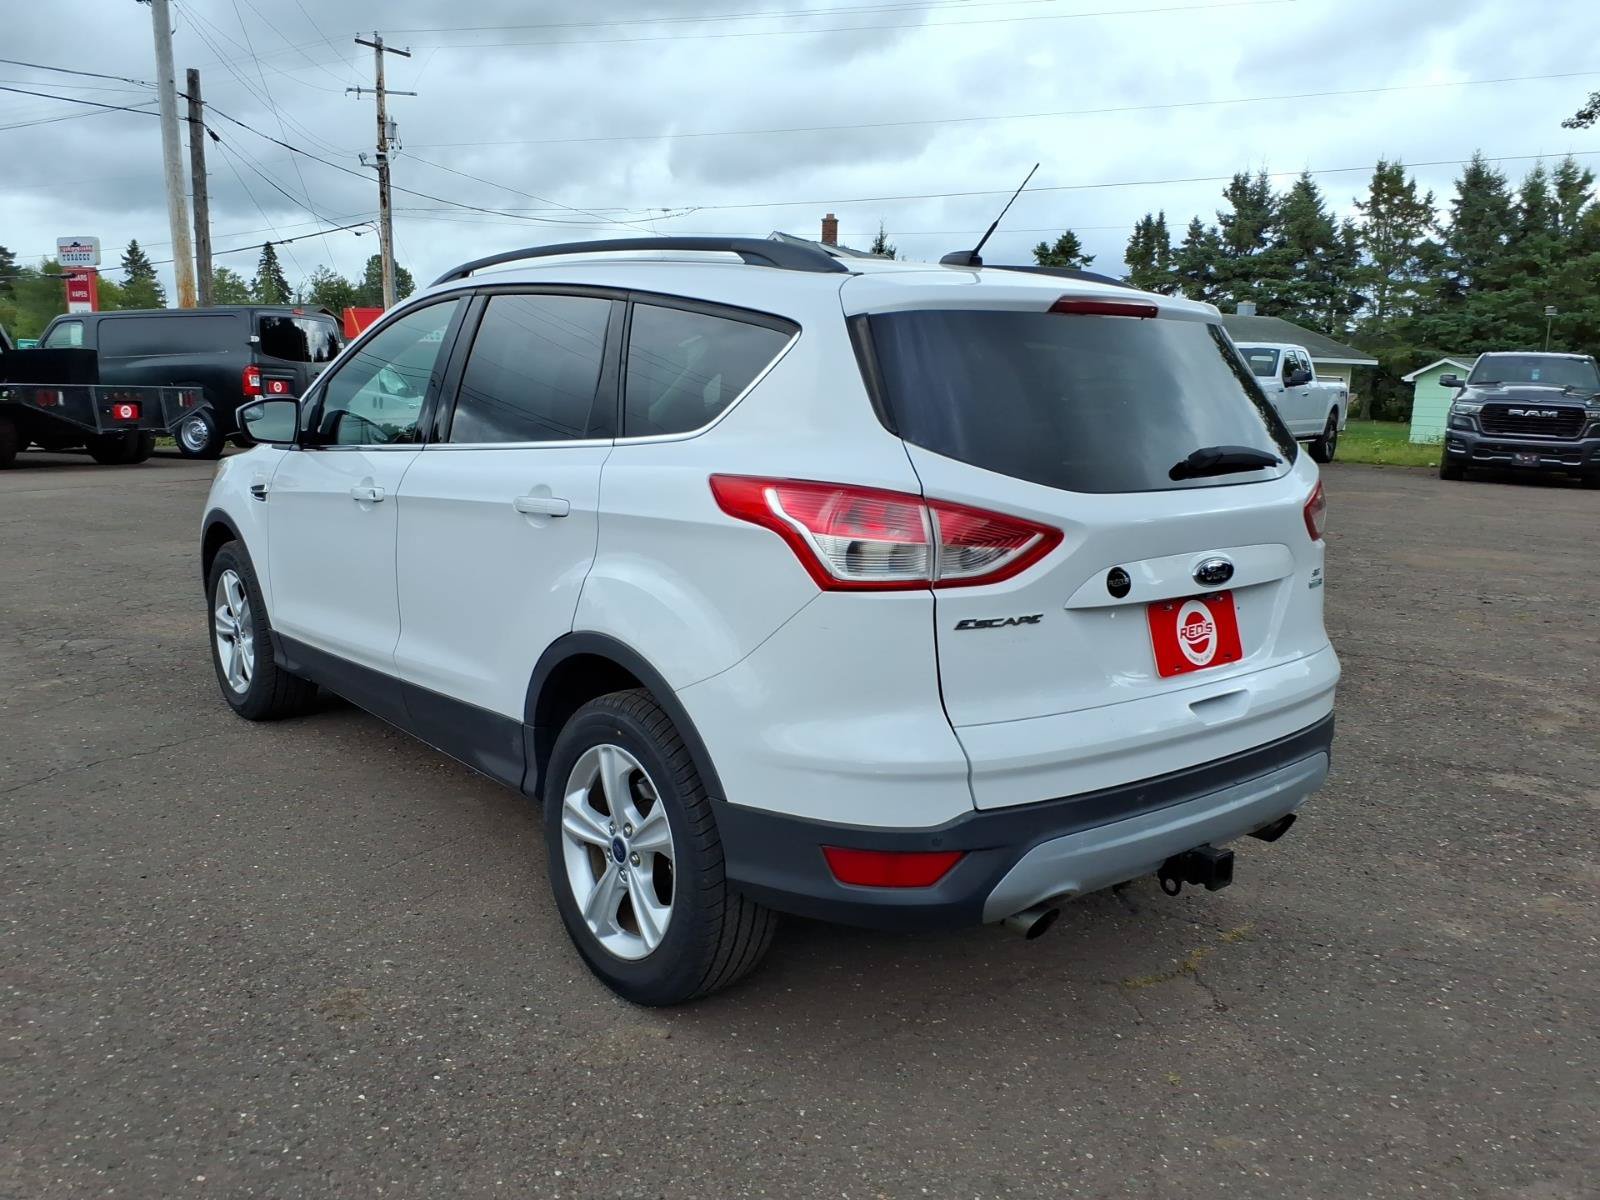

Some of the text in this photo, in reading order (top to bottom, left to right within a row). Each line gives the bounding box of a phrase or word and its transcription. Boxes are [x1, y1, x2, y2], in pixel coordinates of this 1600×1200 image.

[1508, 409, 1558, 417] RAM
[953, 613, 1044, 630] ESCAPE
[1179, 620, 1213, 640] RED'S
